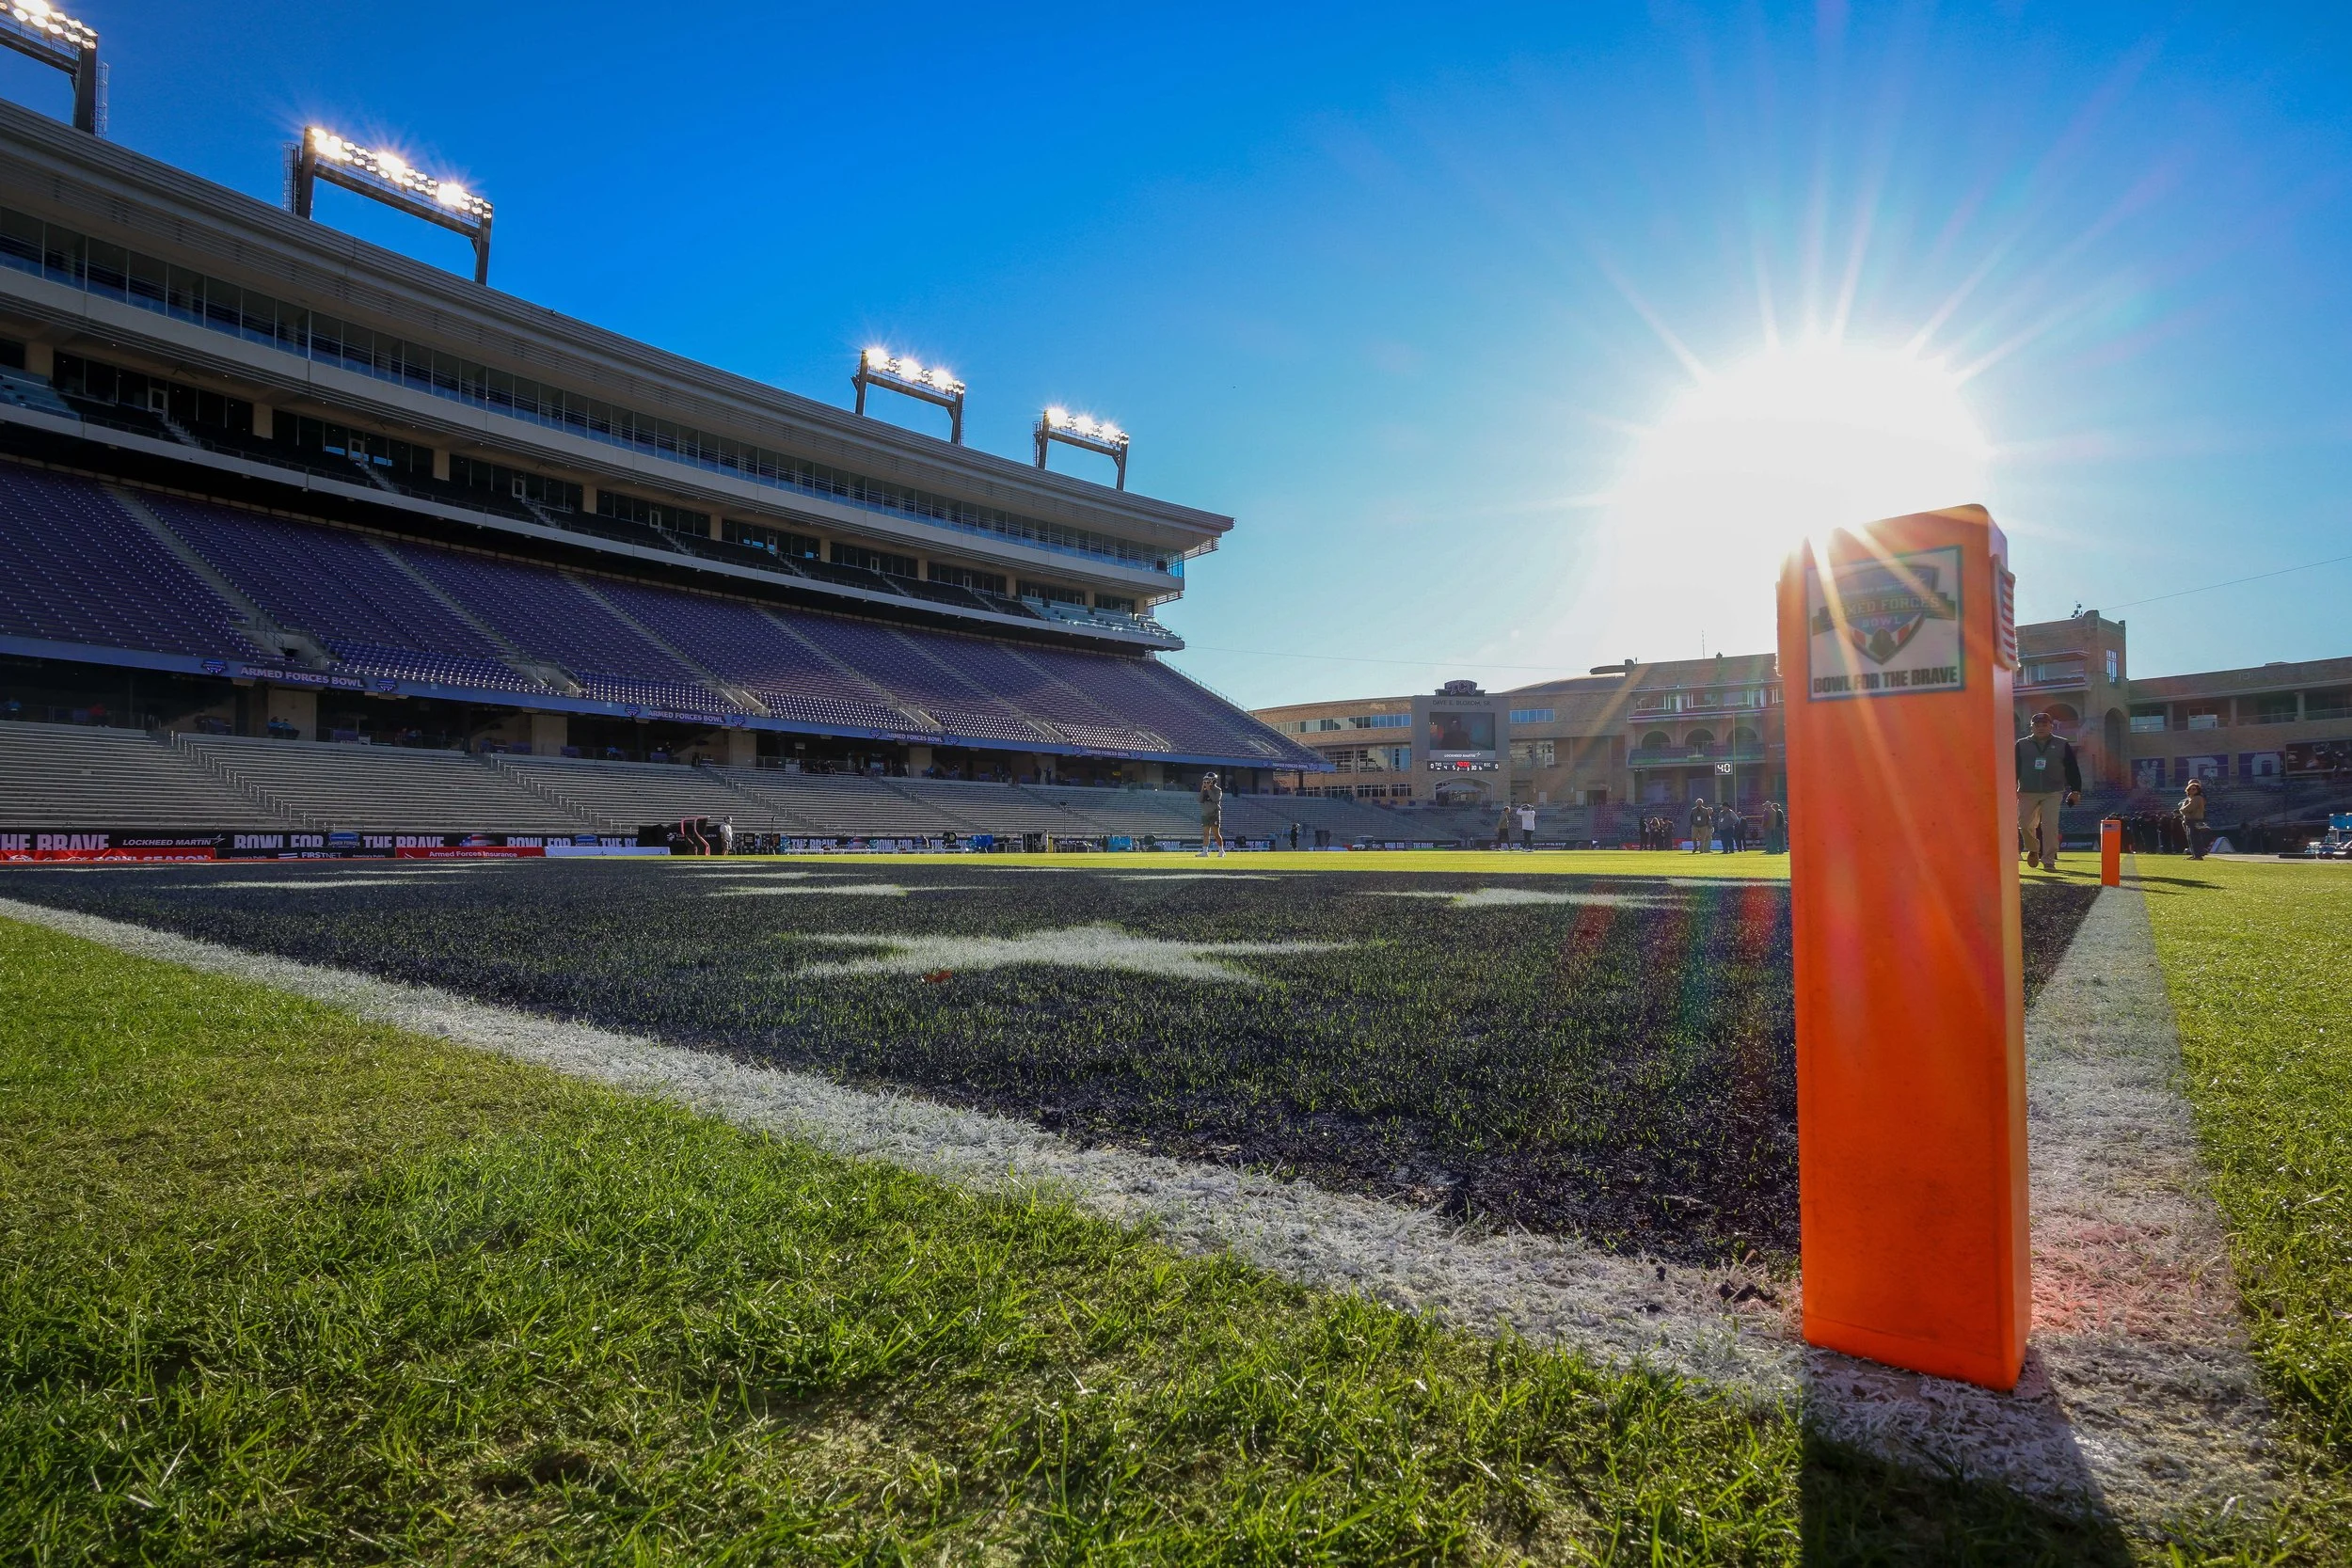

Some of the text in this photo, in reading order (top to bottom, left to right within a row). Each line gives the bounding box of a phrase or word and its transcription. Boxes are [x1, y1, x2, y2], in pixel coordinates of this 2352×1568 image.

[1882, 596, 1940, 611] FORCES
[1862, 616, 1901, 628] BOWL
[241, 667, 364, 688] ARMED FORCES BOWL
[1813, 666, 1958, 693] BOWL FOR THE BRAVE
[1445, 682, 1476, 695] TCU
[647, 710, 724, 723] ARMED FORCES BOWL
[1717, 763, 1731, 773] 40
[0, 833, 110, 850] HE BRAVE
[234, 834, 445, 848] BOWL FOR THE BRAVE
[507, 836, 543, 847] BOWL
[548, 837, 572, 847] FOR
